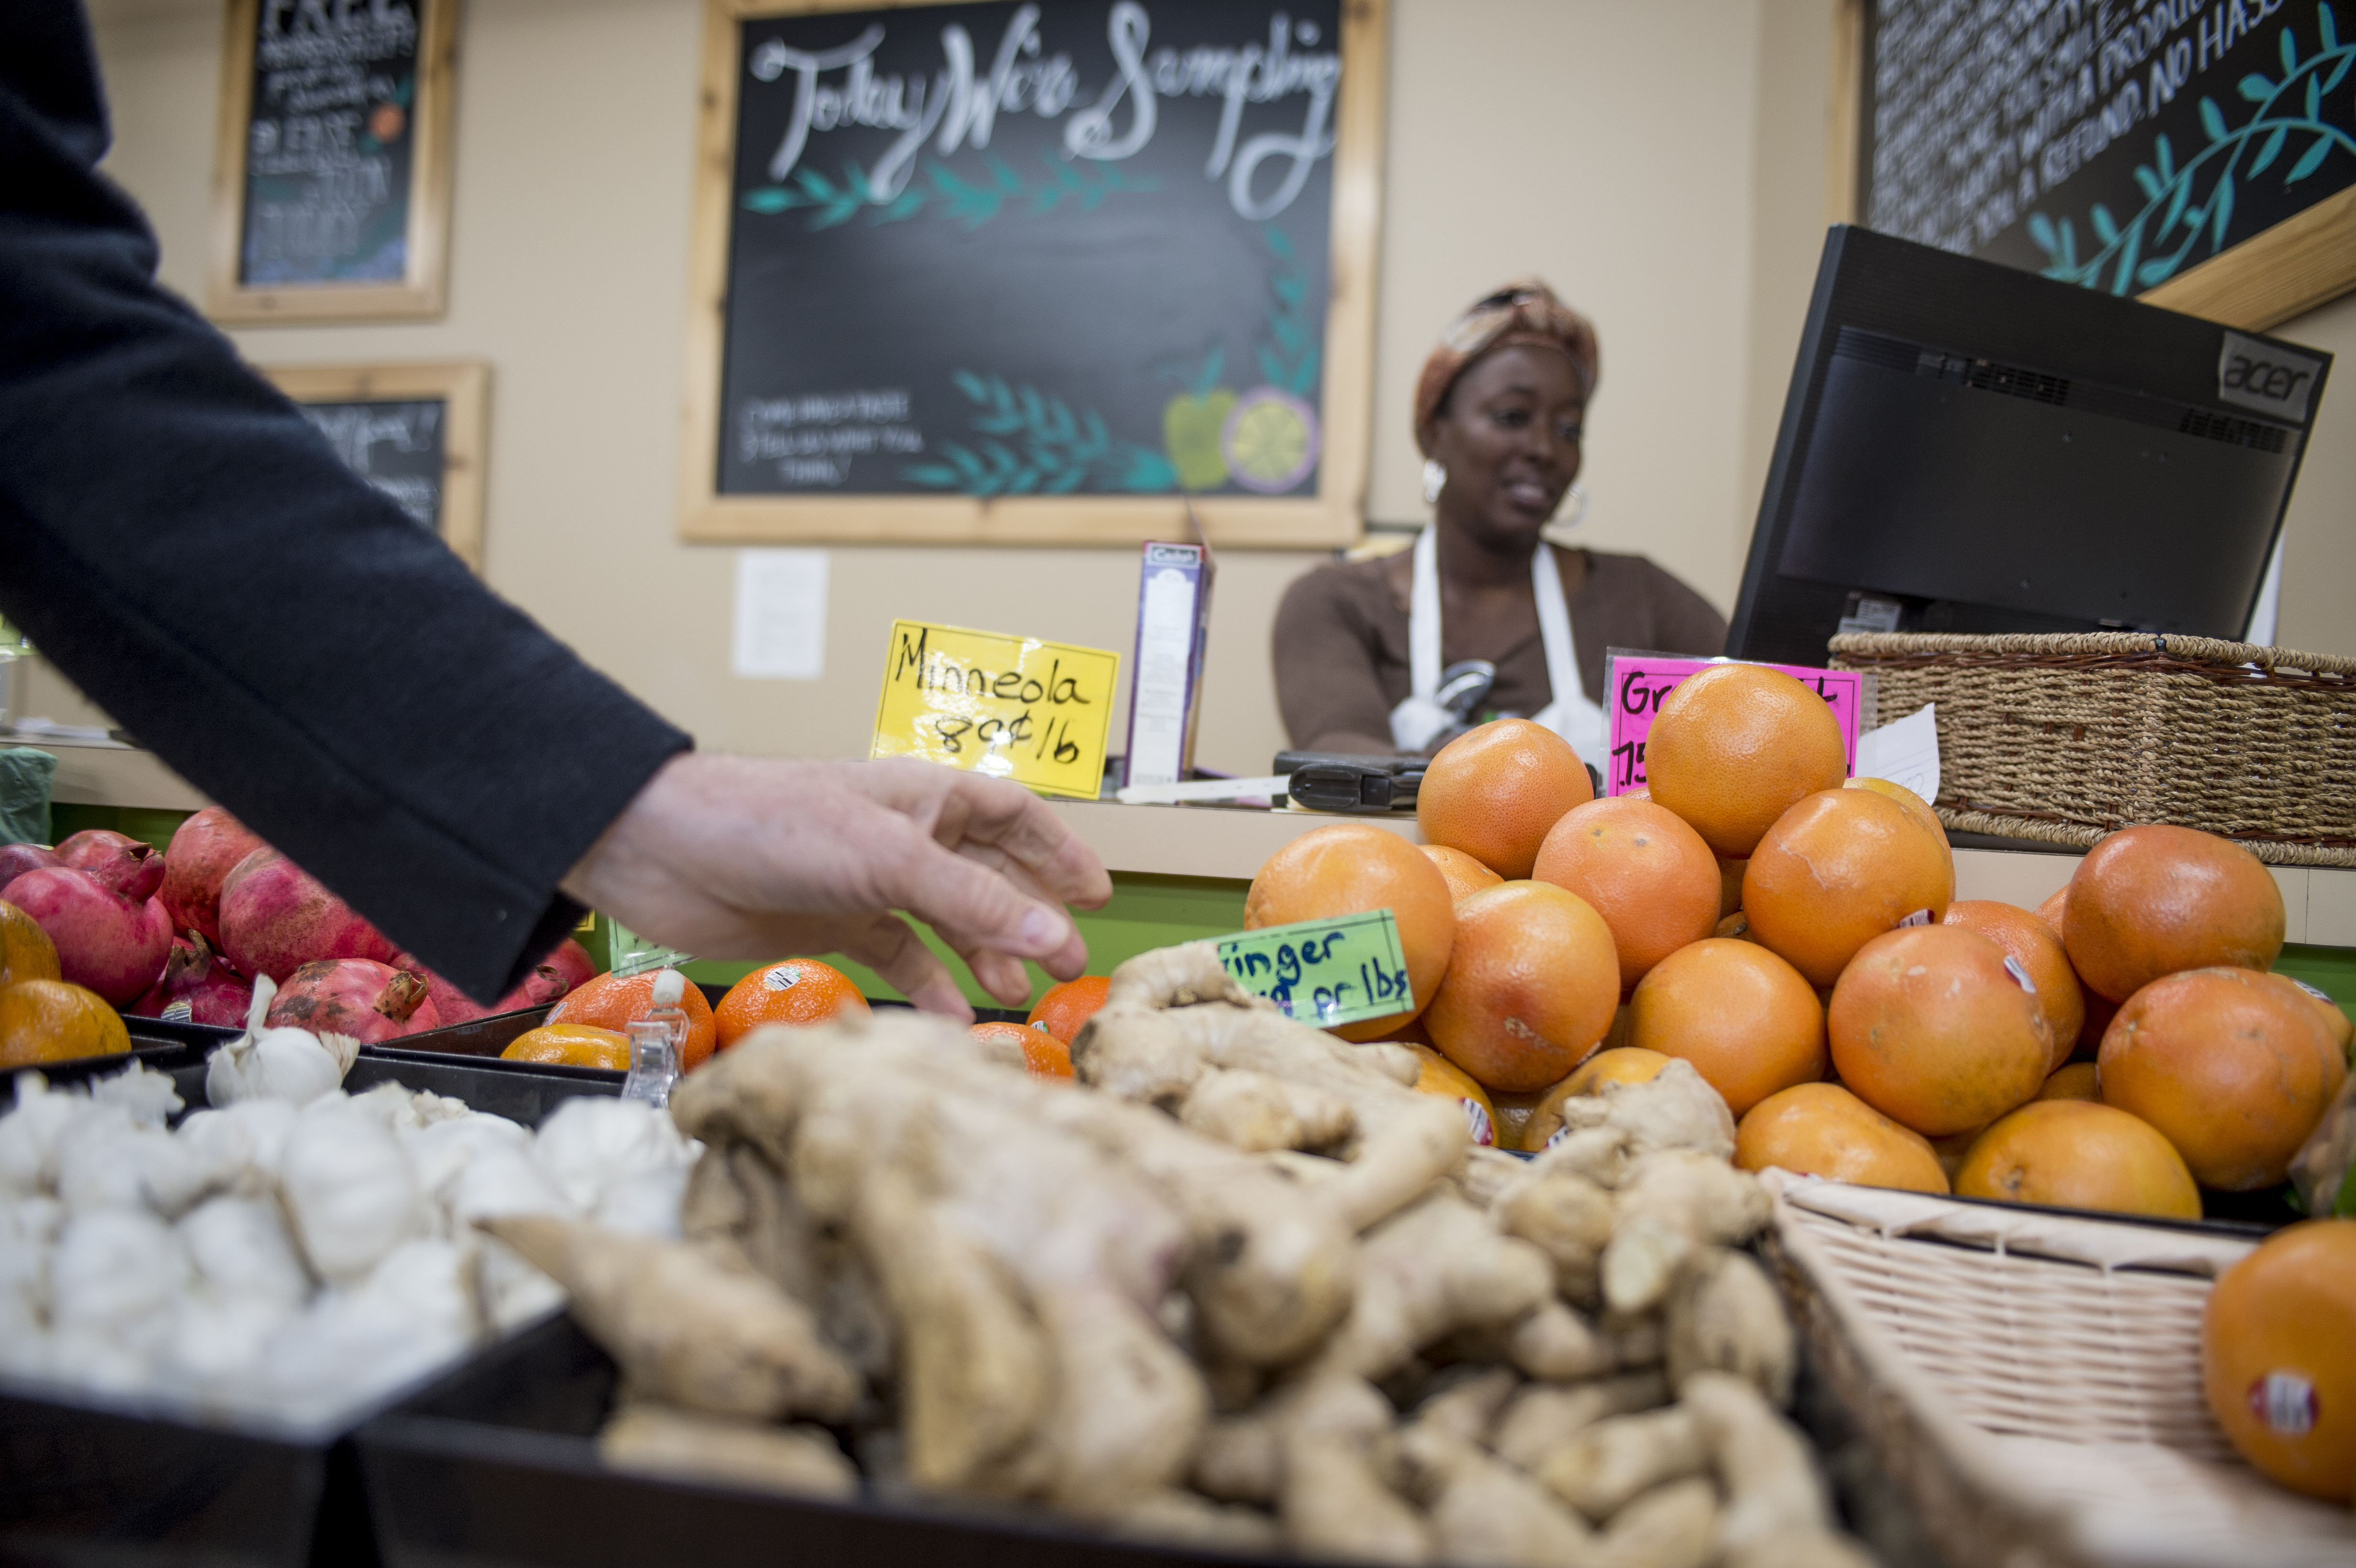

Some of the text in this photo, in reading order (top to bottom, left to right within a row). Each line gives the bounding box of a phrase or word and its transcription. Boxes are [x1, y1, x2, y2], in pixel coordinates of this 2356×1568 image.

[750, 22, 952, 205] Today
[1062, 0, 1342, 220] Sampling
[2148, 36, 2193, 119] NO
[2224, 354, 2310, 402] acer
[895, 628, 1091, 705] Minneola
[1218, 932, 1345, 986] inger
